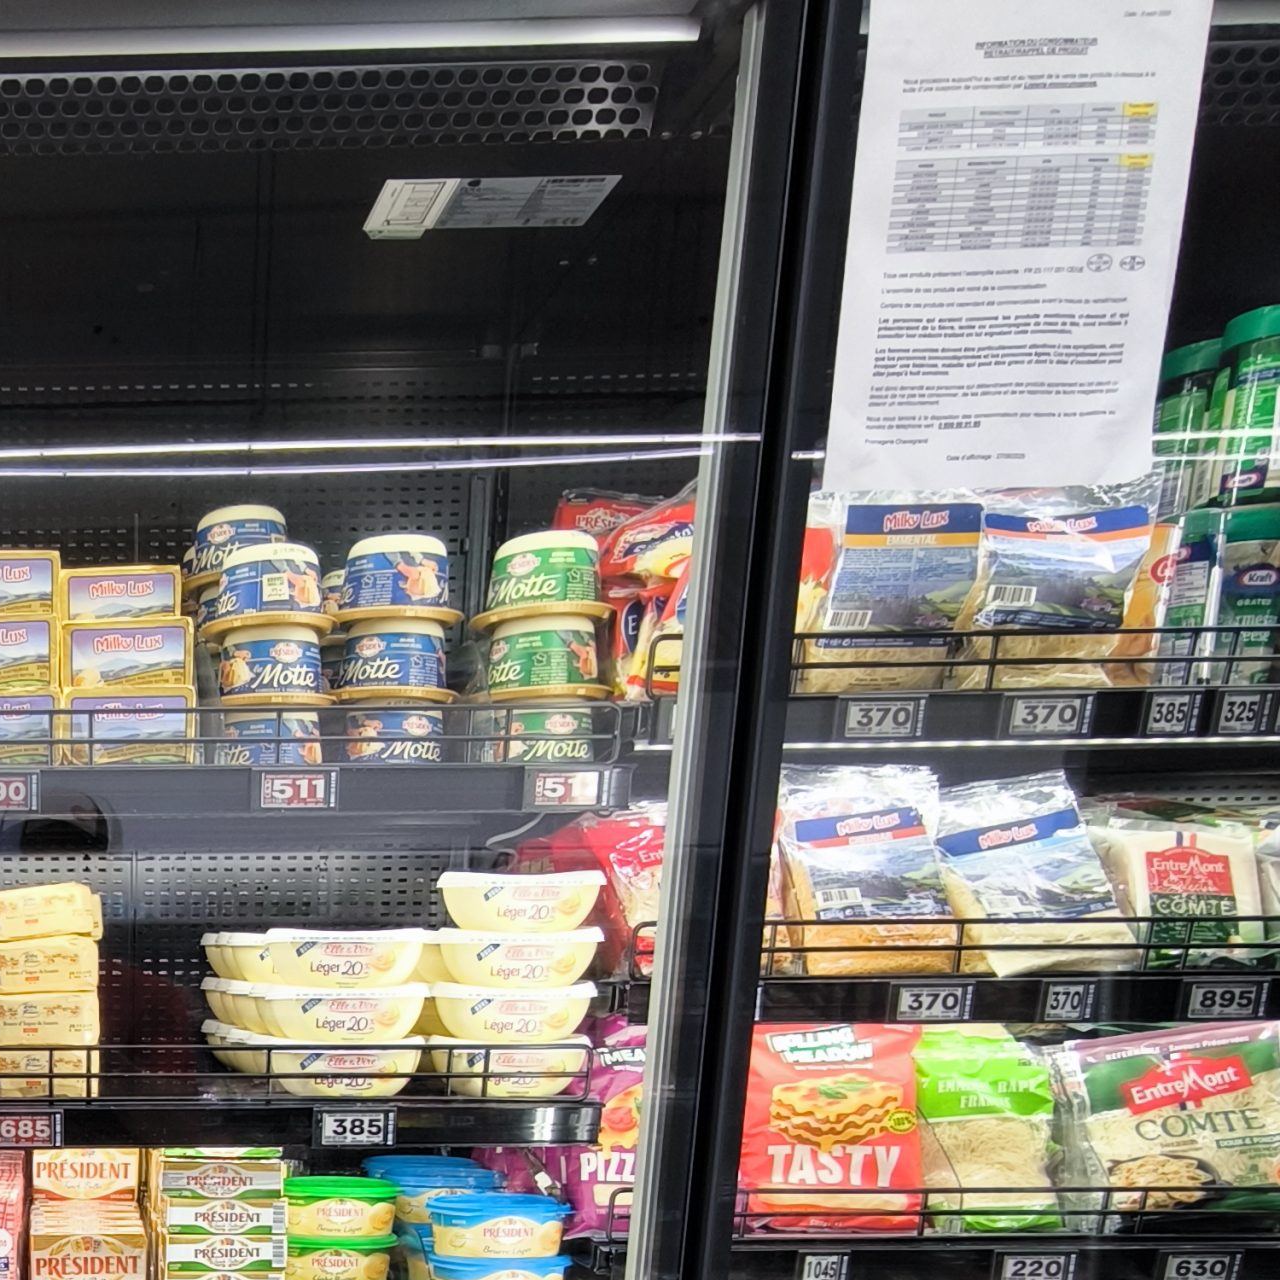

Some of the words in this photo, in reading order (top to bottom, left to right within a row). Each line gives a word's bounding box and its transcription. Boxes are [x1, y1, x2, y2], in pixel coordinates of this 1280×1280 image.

[884, 514, 918, 532] Milky
[921, 511, 949, 528] Lux
[886, 535, 937, 545] EMMENTAL
[1, 564, 31, 582] Lux
[1246, 571, 1274, 585] Kraft
[89, 581, 124, 598] Milky
[127, 580, 154, 596] Lux
[494, 577, 556, 599] Motte
[0, 628, 27, 645] Lux
[93, 636, 131, 652] Milky
[134, 635, 164, 650] Lux
[259, 663, 315, 688] Motte
[857, 707, 910, 727] 370
[1021, 704, 1077, 725] 370
[1153, 701, 1187, 724] 385
[1224, 700, 1257, 722] 325
[271, 780, 324, 799] 511
[1152, 857, 1225, 875] EntreMont
[310, 961, 340, 977] Léger
[342, 960, 364, 977] 20
[908, 992, 960, 1010] 370
[1050, 990, 1082, 1010] 370
[1200, 989, 1253, 1008] 895
[315, 1016, 346, 1032] Léger
[347, 1016, 369, 1032] 20
[1129, 1066, 1239, 1104] EntreMont
[0, 1121, 50, 1138] 685
[332, 1118, 382, 1136] 385
[36, 1160, 131, 1179] PRÉSIDENT
[580, 1152, 636, 1182] PIZZ
[767, 1143, 900, 1186] TASTY
[194, 1212, 261, 1223] PRÉSIDENT
[194, 1248, 261, 1259] PRÉSIDENT
[35, 1256, 141, 1276] PRÉSIDENT
[806, 1259, 837, 1280] 1045
[1011, 1260, 1062, 1277] 220
[1175, 1259, 1227, 1276] 630
